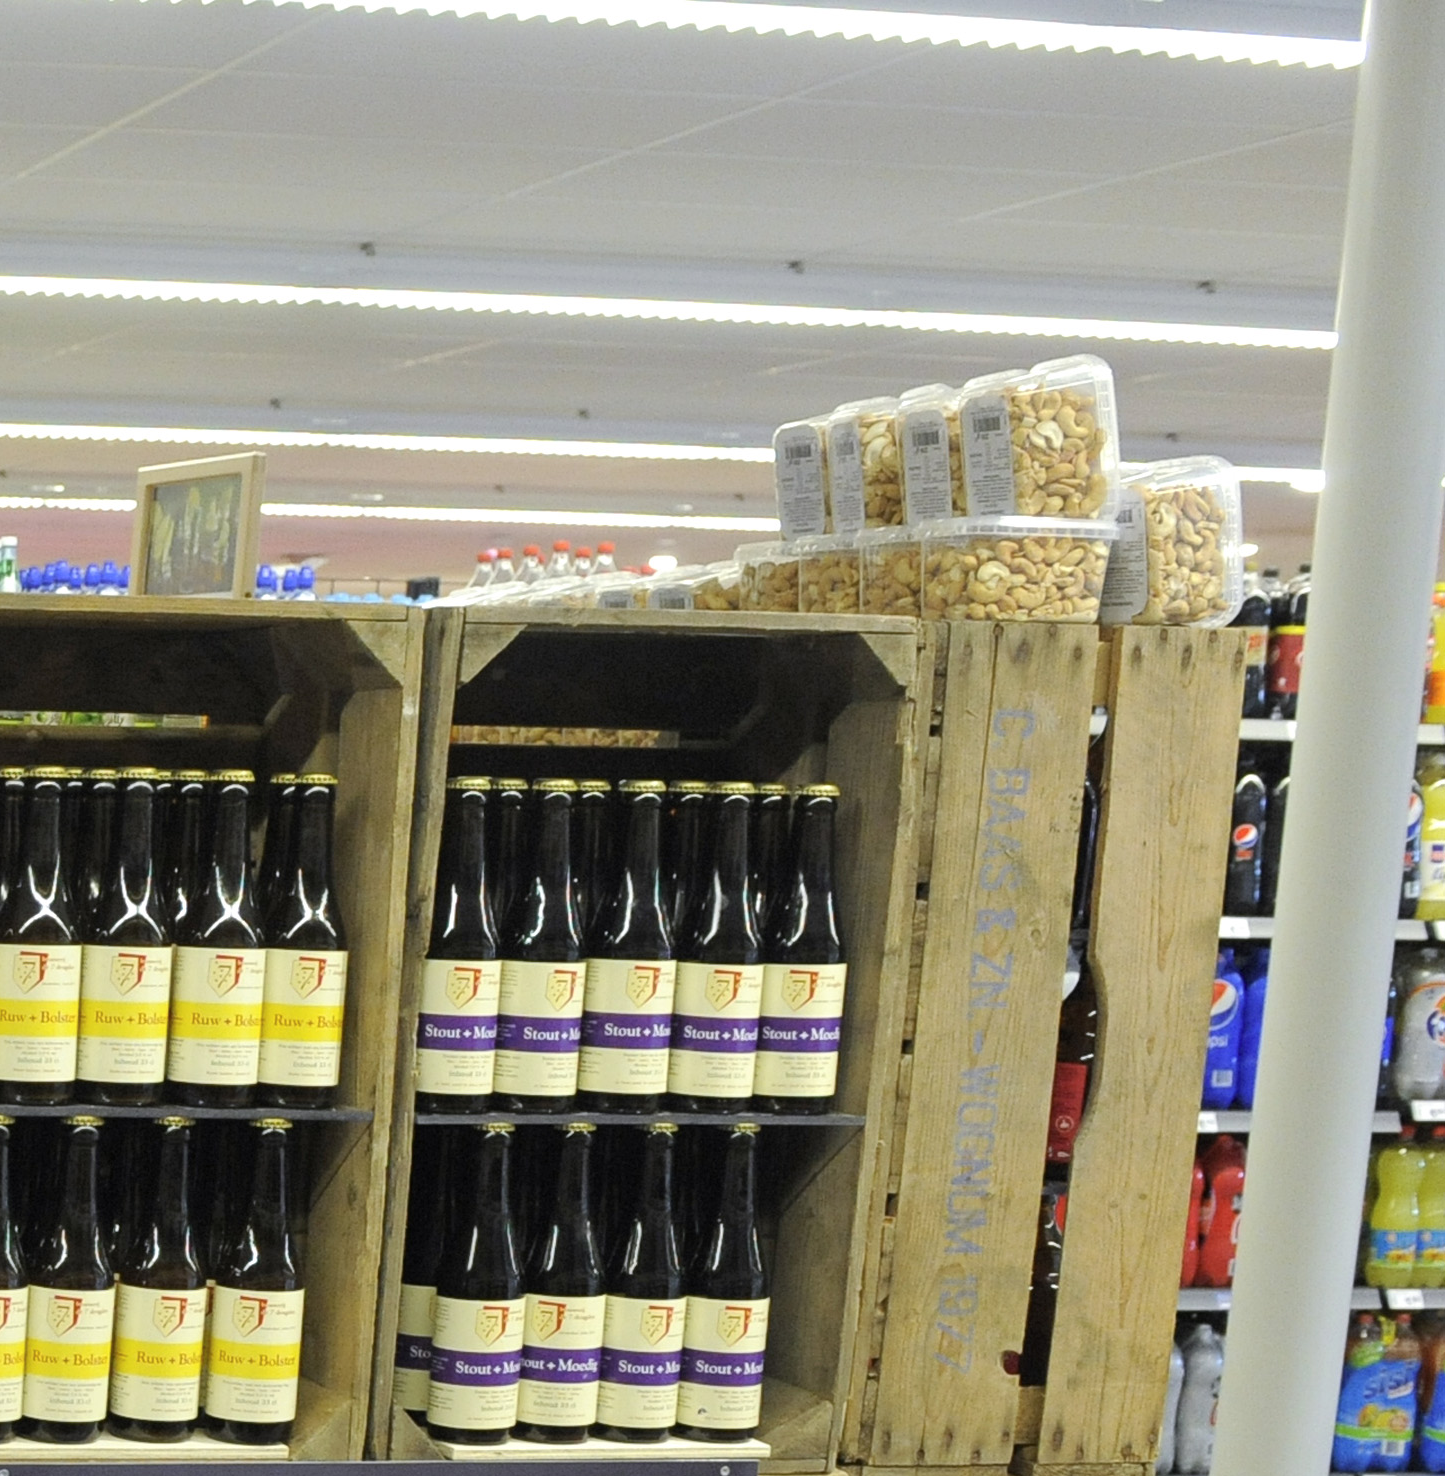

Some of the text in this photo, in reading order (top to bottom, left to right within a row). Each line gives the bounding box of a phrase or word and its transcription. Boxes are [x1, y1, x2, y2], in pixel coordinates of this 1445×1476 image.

[976, 768, 1029, 891] BAAS
[425, 1023, 461, 1039] Stout
[941, 1064, 1001, 1255] WOGNUM
[933, 1272, 979, 1375] 1977
[218, 1350, 245, 1364] Ruw
[455, 1360, 491, 1376] Stout
